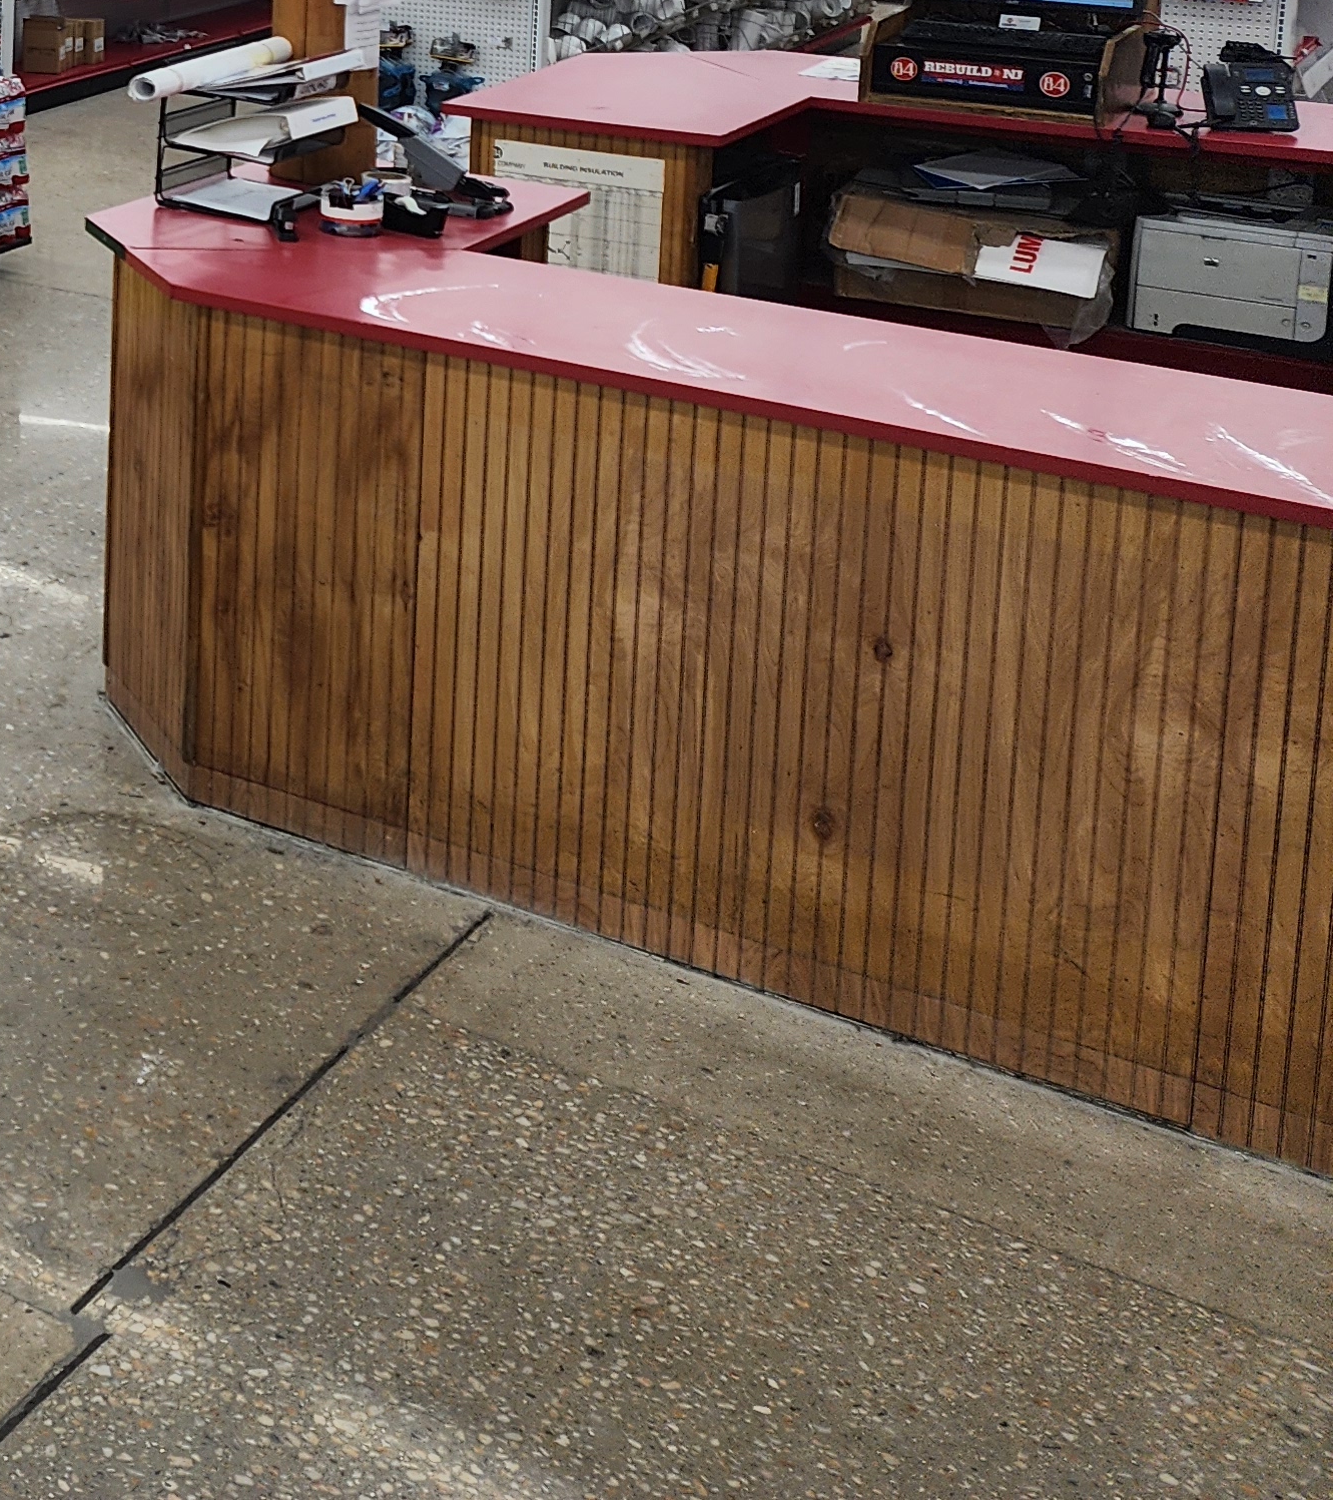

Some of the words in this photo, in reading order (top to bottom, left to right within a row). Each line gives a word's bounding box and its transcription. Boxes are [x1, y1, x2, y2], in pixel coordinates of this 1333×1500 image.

[893, 61, 915, 76] 84
[924, 60, 992, 77] REBUILD
[1002, 68, 1025, 80] NJ
[1042, 76, 1066, 92] 84
[579, 166, 624, 178] INSULATION
